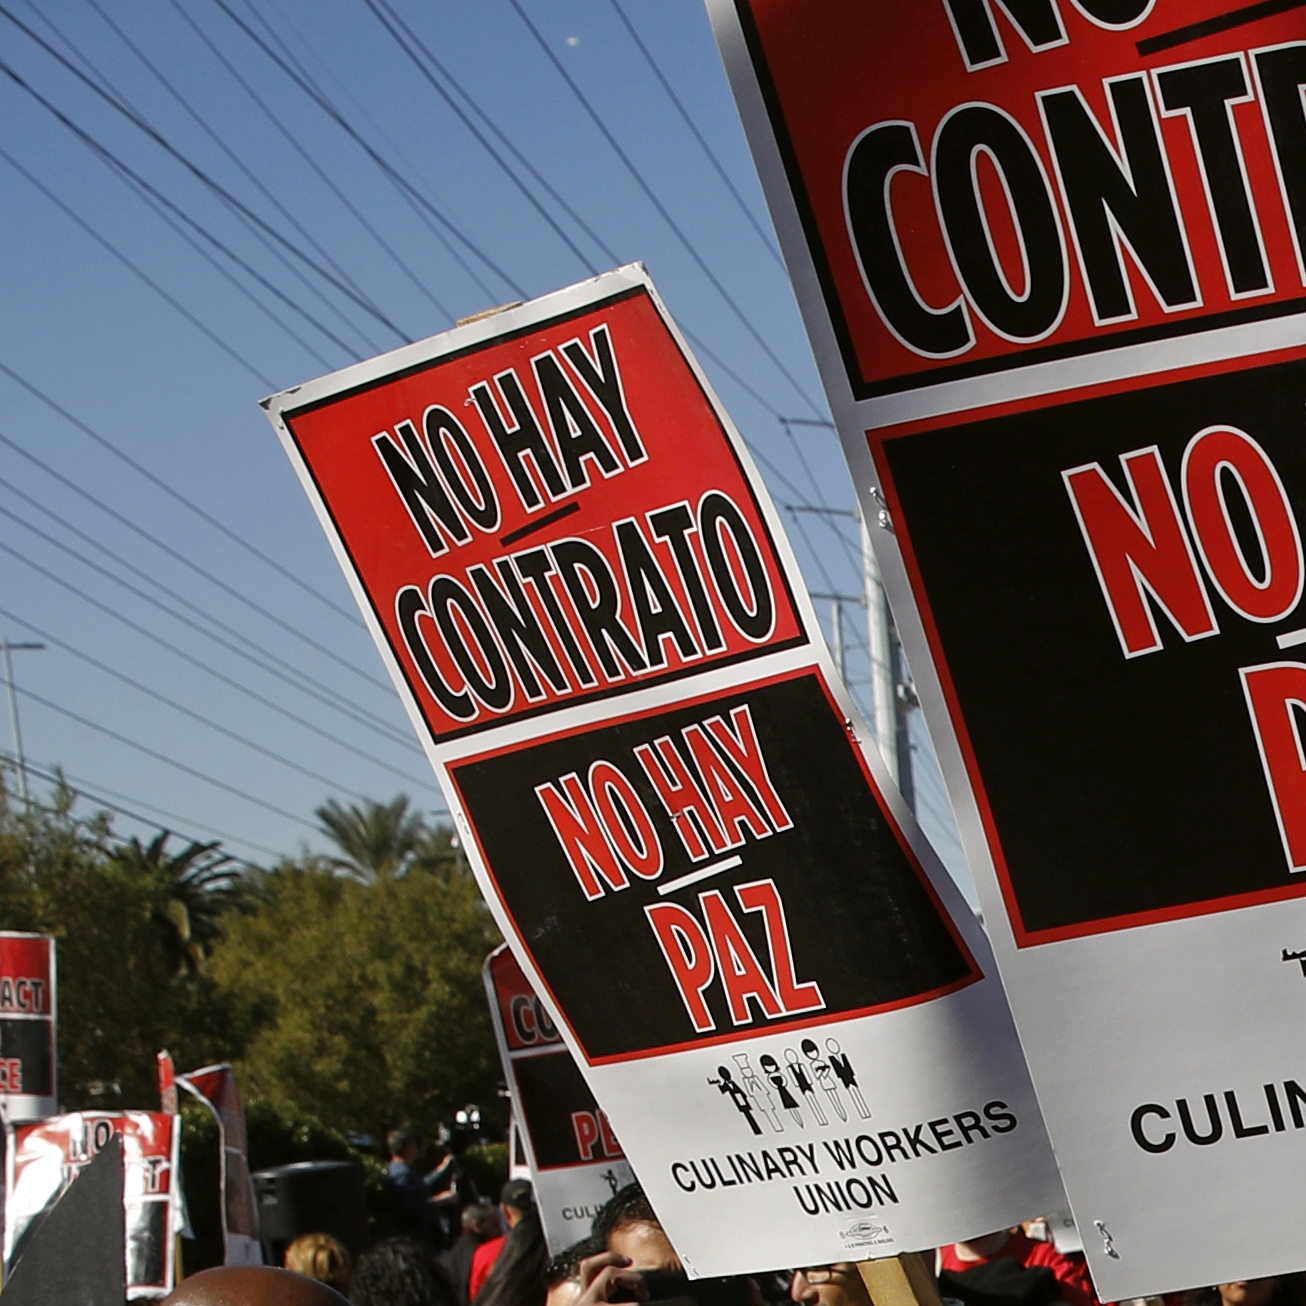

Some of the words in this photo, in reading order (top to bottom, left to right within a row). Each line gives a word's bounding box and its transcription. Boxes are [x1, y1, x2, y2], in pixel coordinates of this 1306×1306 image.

[371, 404, 502, 559] NO
[470, 323, 648, 514] HAY
[395, 490, 778, 722] CONTRATO
[1061, 424, 1305, 660] NO
[534, 760, 663, 901] NO
[633, 703, 795, 862] HAY
[643, 878, 826, 1033] PAZ
[671, 1143, 820, 1193] CULINARY
[823, 1100, 1018, 1171] WORKERS
[794, 1173, 901, 1216] UNION
